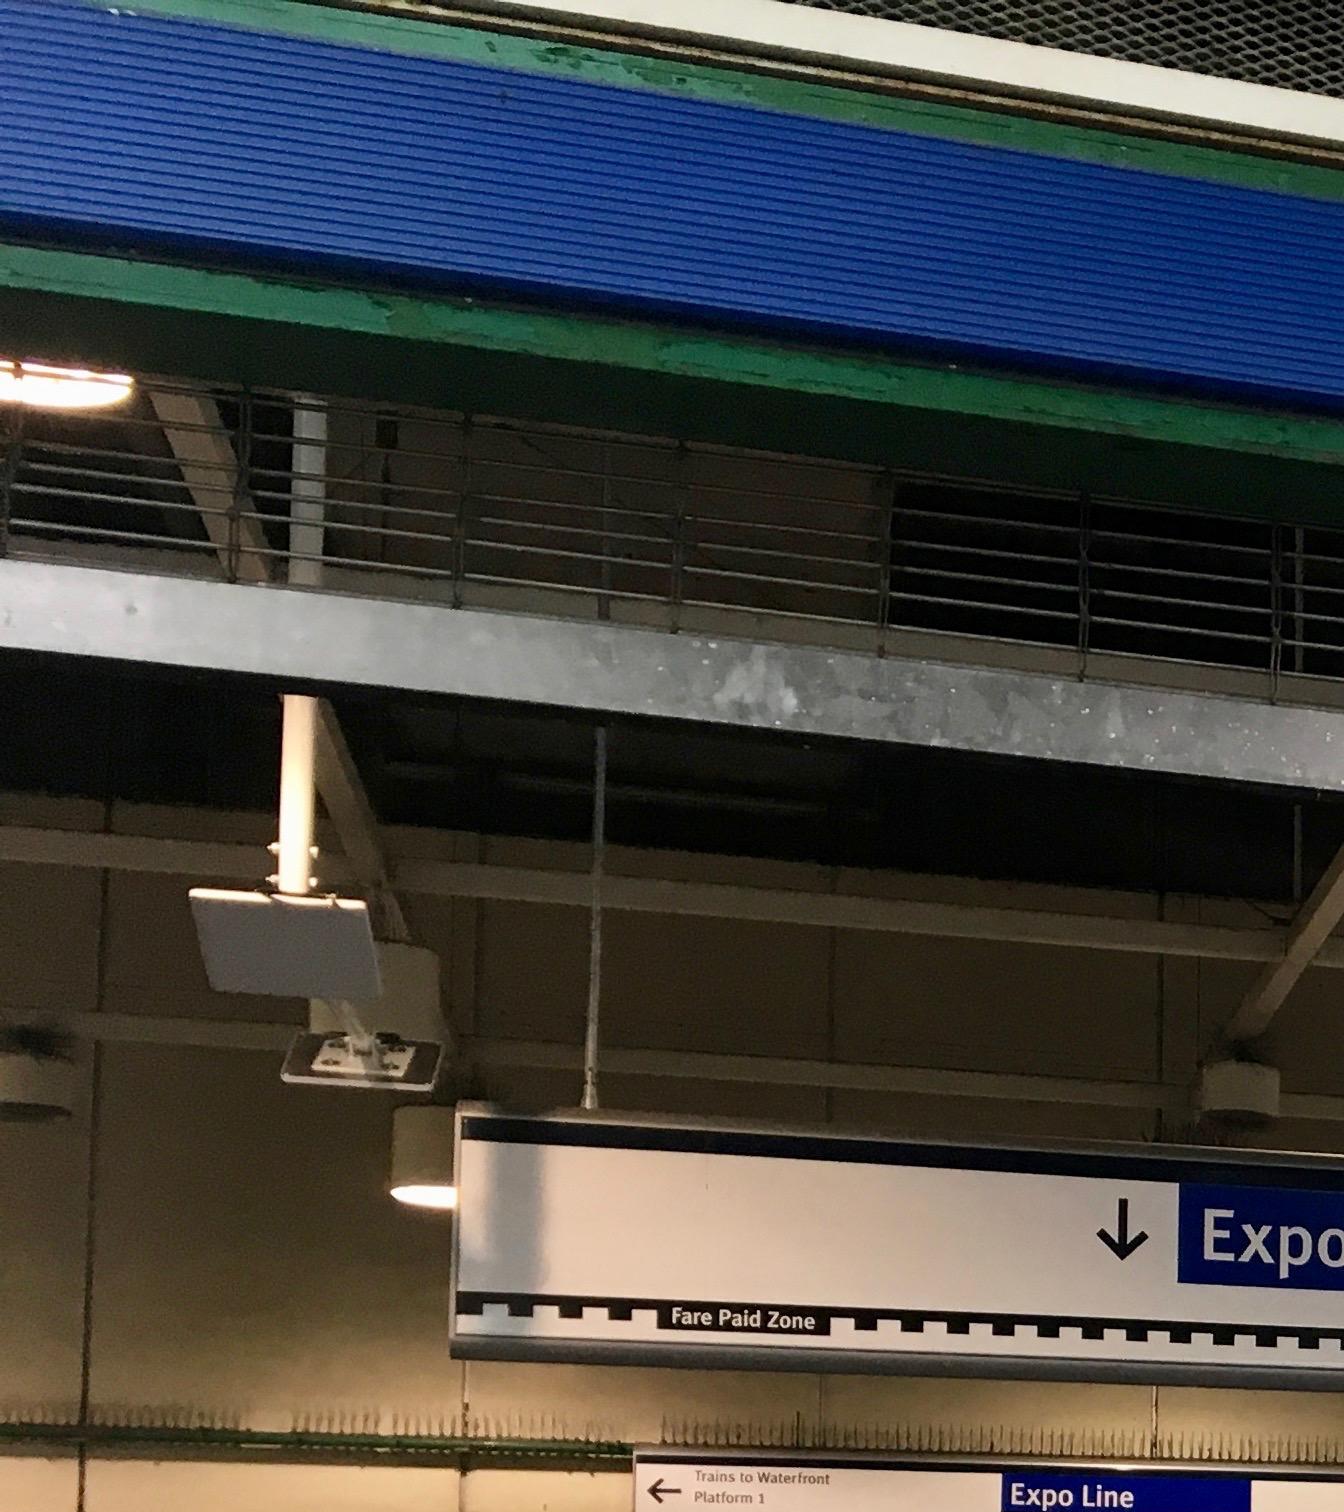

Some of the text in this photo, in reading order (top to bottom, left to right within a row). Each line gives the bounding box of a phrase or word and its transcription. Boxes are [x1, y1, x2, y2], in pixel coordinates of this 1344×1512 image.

[671, 1306, 816, 1331] Fare Paid Zone
[694, 1468, 830, 1487] Trains to Waterfront
[694, 1490, 766, 1506] Platform 1
[1010, 1482, 1134, 1512] Expo Line
